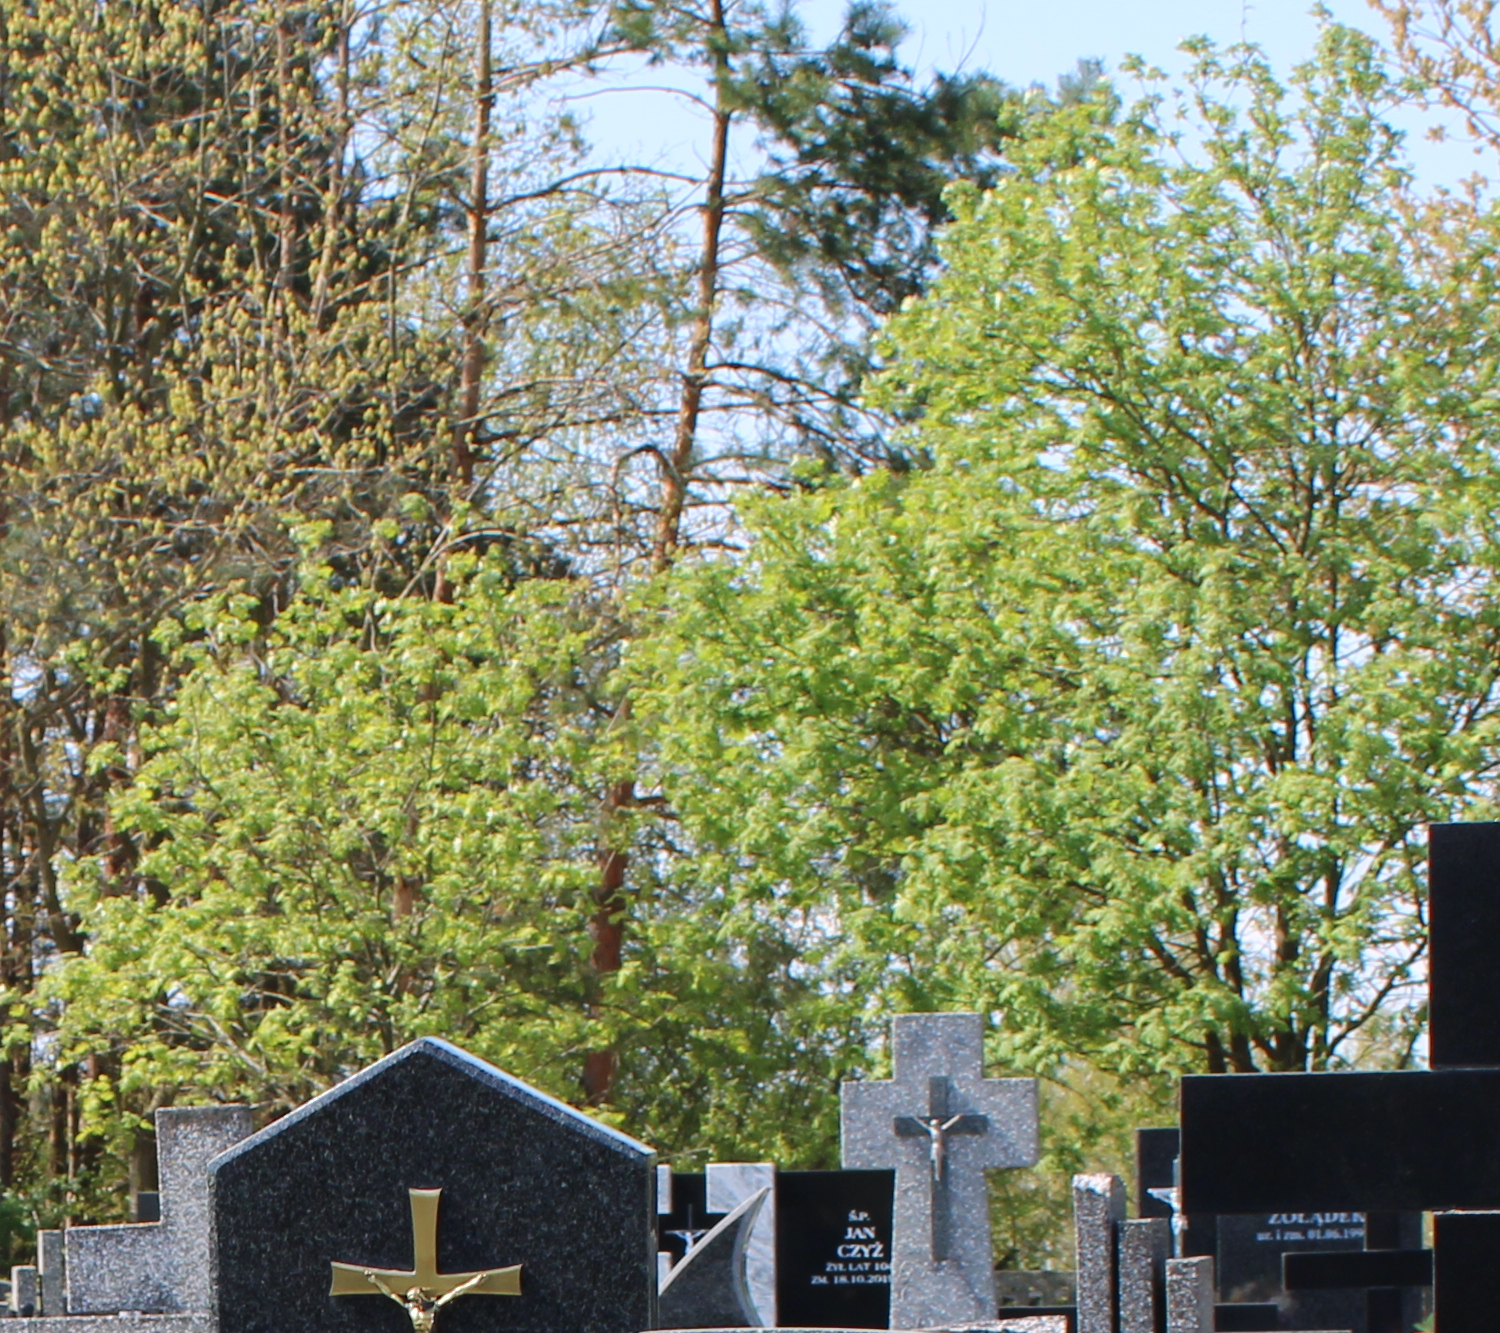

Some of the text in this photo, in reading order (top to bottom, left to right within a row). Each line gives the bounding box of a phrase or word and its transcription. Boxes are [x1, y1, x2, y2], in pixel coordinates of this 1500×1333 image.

[844, 1226, 876, 1240] JAN
[837, 1241, 885, 1258] CZYŻ
[848, 1262, 871, 1272] LAT
